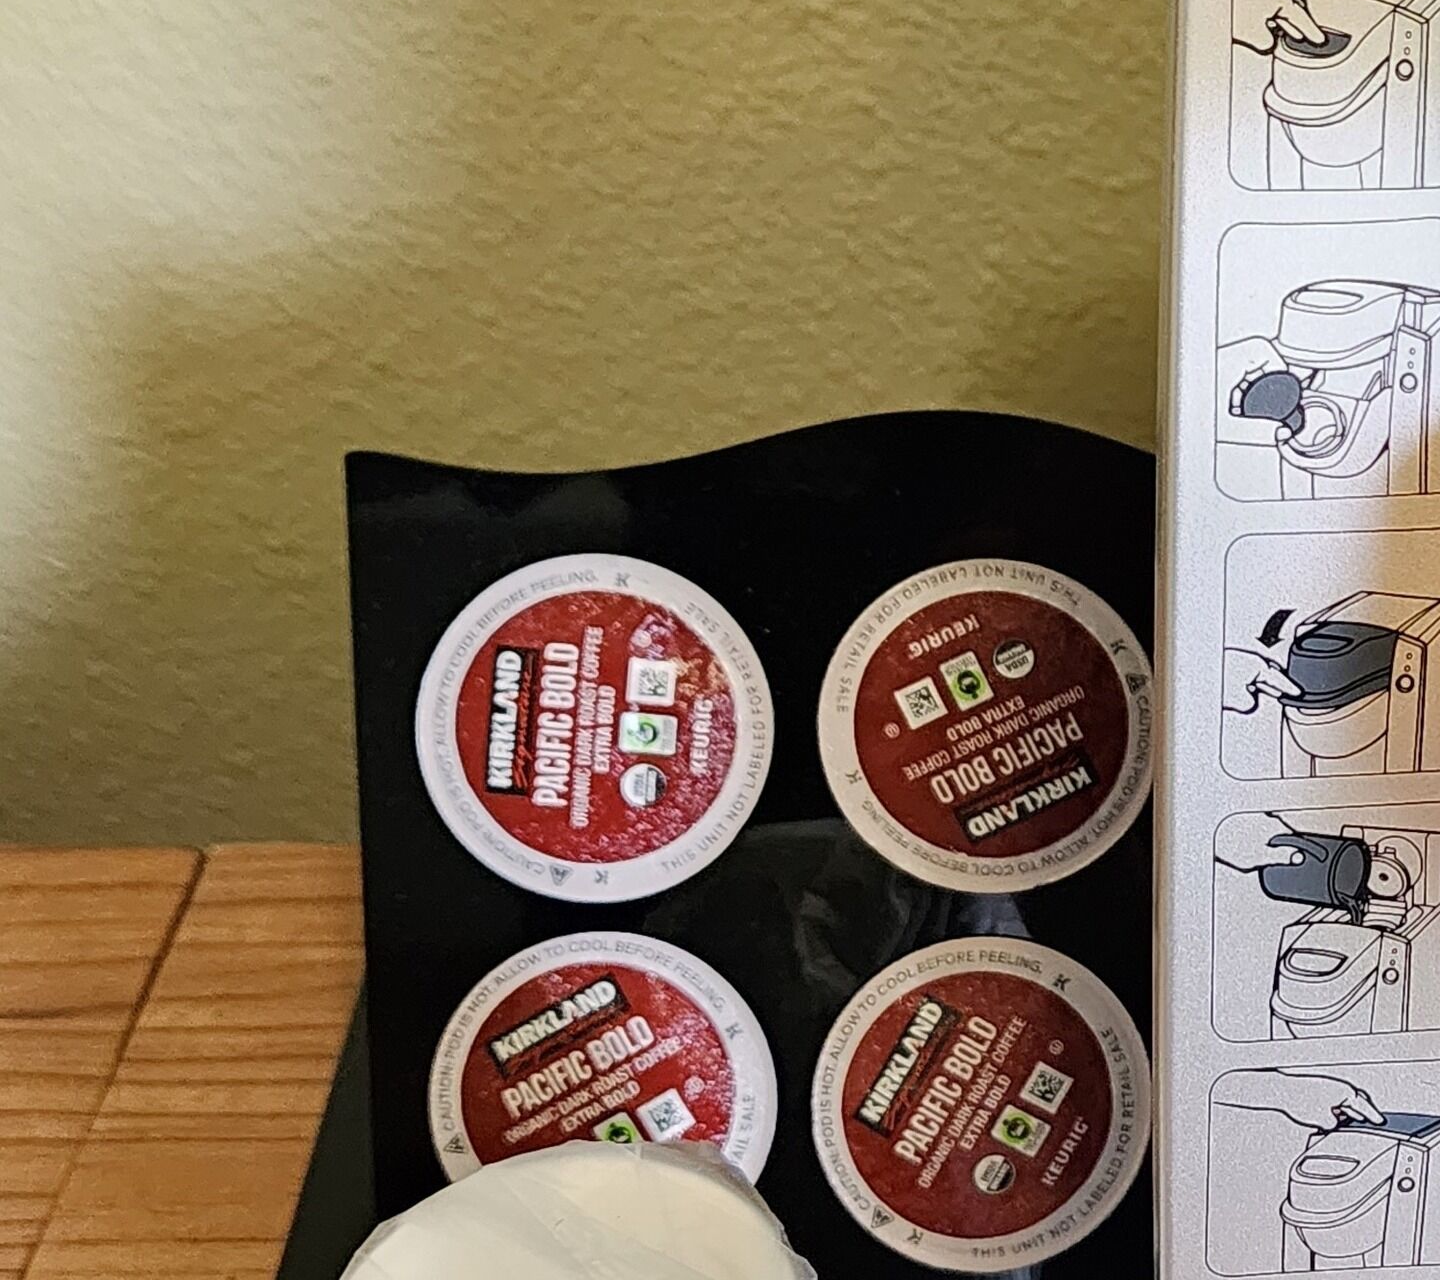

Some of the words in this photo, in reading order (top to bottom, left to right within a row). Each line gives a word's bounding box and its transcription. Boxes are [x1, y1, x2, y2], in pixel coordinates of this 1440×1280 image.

[974, 565, 1004, 576] NOT
[581, 626, 602, 678] COFFEE
[904, 614, 979, 656] KEURIG
[541, 642, 578, 709] BOLD
[835, 677, 854, 710] SALE
[486, 650, 523, 788] KIRKLAND
[579, 681, 597, 725] ROAST
[746, 686, 763, 714] FOR
[982, 696, 1024, 723] EXTRA
[1027, 685, 1084, 720] ORGANIC
[576, 729, 593, 764] DARK
[688, 698, 713, 773] KEURIG
[946, 716, 981, 740] BOLD
[951, 730, 991, 756] ROAST
[989, 712, 1083, 775] PACIFIC
[992, 713, 1027, 737] DARK
[532, 714, 573, 807] PACIFIC
[594, 727, 612, 772] EXTRA
[741, 722, 764, 788] LABELED
[903, 749, 949, 778] COFFEE
[570, 768, 591, 827] ORGANIC
[928, 754, 993, 804] BOLD
[965, 766, 1092, 837] KIRKLAND
[724, 791, 749, 822] NOT
[696, 821, 727, 852] UNIT
[1041, 835, 1088, 866] ALLOW
[661, 847, 696, 874] THIS
[972, 862, 1013, 875] COOL
[493, 953, 540, 985] ALLOW
[568, 940, 609, 953] COOL
[617, 943, 672, 966] BEFORE
[492, 977, 618, 1063] KIRKLAND
[822, 1117, 836, 1147] POD
[830, 1012, 860, 1059] ALLOW
[877, 967, 914, 996] COOL
[916, 951, 972, 973] BEFORE
[858, 999, 946, 1122] KIRKLAND
[1100, 1027, 1125, 1061] SALE
[499, 1049, 594, 1122] PACIFIC
[585, 1013, 655, 1072] BOLD
[505, 1106, 559, 1145] ORGANIC
[558, 1086, 594, 1114] DARK
[593, 1063, 633, 1094] ROAST
[632, 1034, 683, 1072] COFFEE
[892, 1074, 965, 1164] PACIFIC
[942, 1014, 1000, 1081] BOLD
[562, 1100, 606, 1133] EXTRA
[603, 1079, 641, 1109] BOLD
[915, 1135, 955, 1187] ORGANIC
[947, 1102, 975, 1137] DARK
[966, 1061, 999, 1103] ROAST
[990, 1015, 1026, 1062] COFFEE
[959, 1107, 992, 1149] EXTRA
[983, 1073, 1012, 1109] BOLD
[1117, 1065, 1132, 1116] RETAIL
[1041, 1118, 1090, 1186] KEURIG
[1115, 1125, 1131, 1153] FOR
[973, 1246, 1004, 1257] THIS
